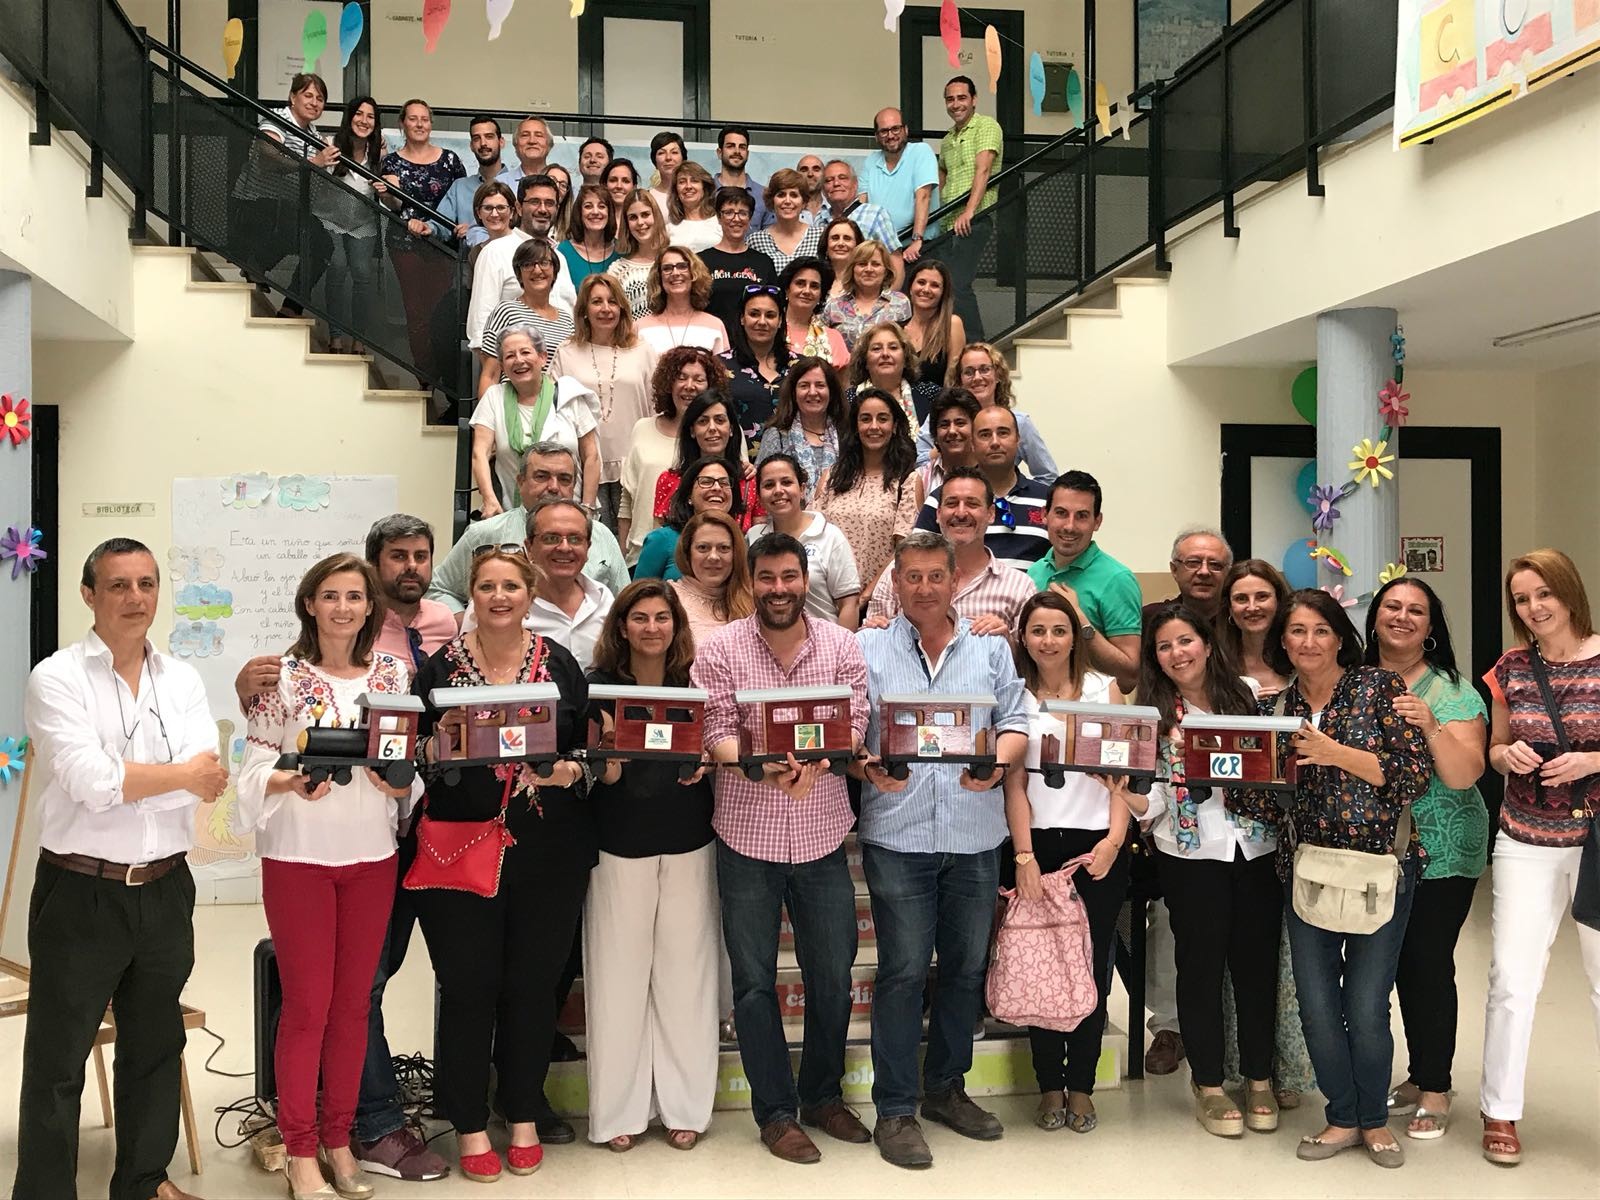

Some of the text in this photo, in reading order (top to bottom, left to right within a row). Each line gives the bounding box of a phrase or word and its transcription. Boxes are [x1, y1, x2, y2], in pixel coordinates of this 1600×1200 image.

[96, 505, 141, 514] BIBLIOTECA
[230, 530, 256, 546] Era
[261, 537, 277, 546] un
[282, 537, 311, 547] niño
[315, 540, 333, 551] que
[256, 552, 271, 560] un
[276, 548, 309, 560] caballo
[383, 739, 394, 758] 6
